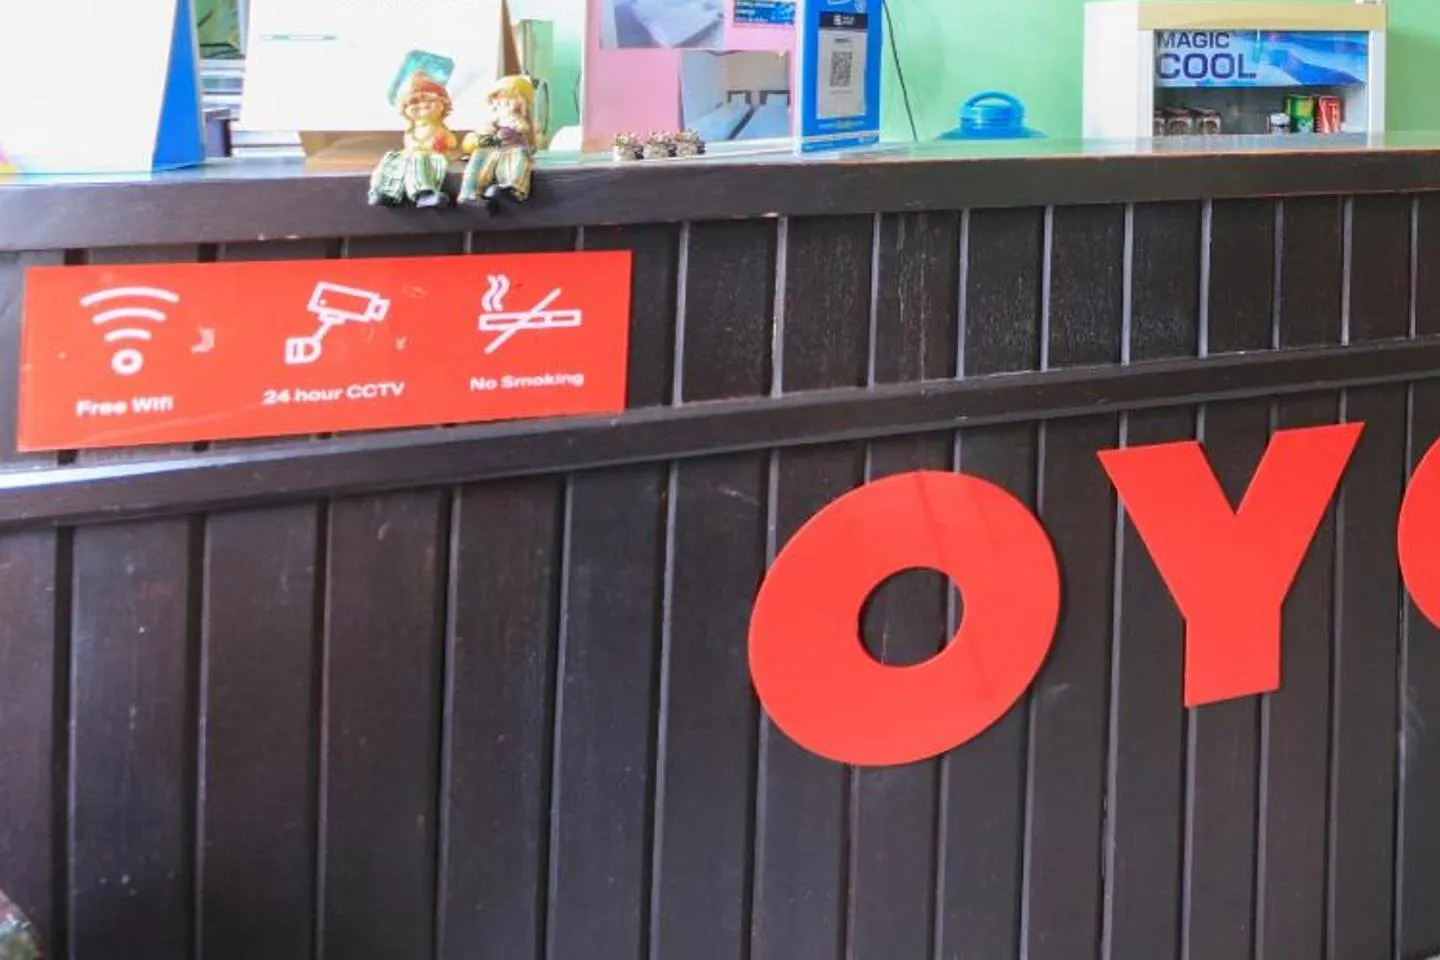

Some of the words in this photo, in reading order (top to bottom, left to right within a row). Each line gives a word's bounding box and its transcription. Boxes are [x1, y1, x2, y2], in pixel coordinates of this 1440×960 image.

[1157, 31, 1230, 49] MAGIC
[1157, 53, 1250, 79] COOL
[469, 375, 498, 392] No
[501, 371, 585, 390] Smoking
[262, 387, 291, 406] 24
[295, 387, 342, 403] hour
[345, 380, 405, 400] CCTV
[75, 398, 128, 417] Free
